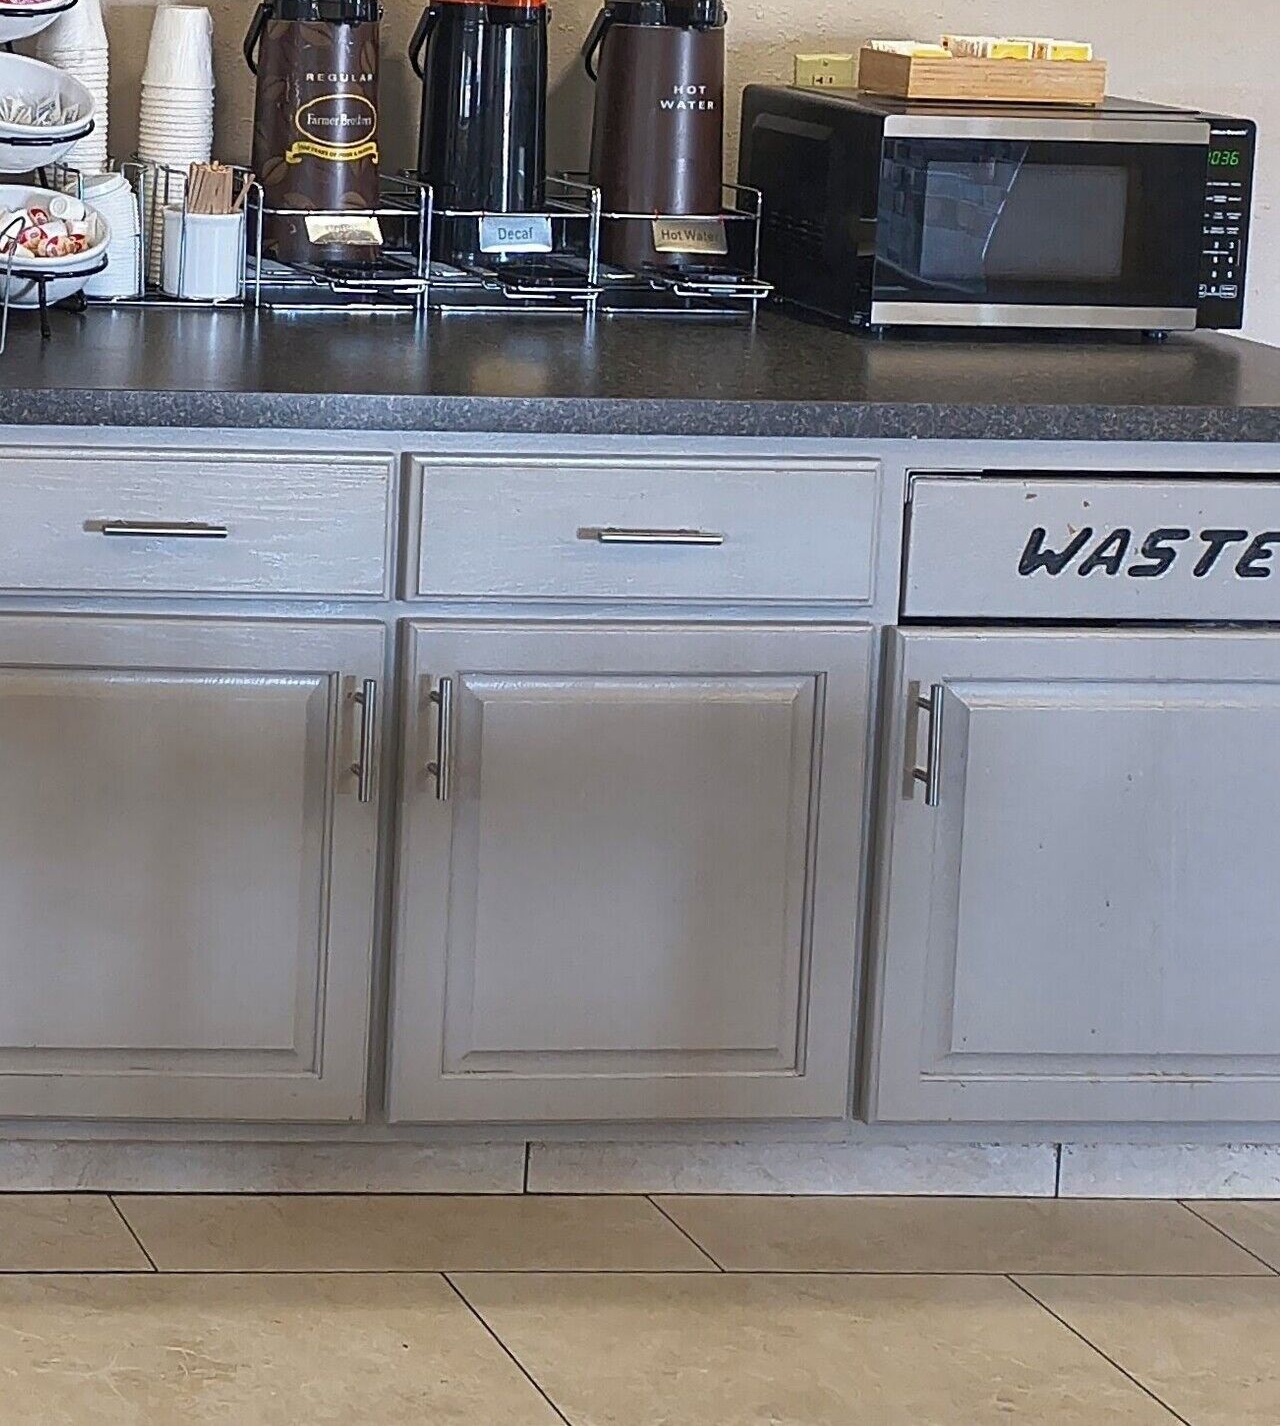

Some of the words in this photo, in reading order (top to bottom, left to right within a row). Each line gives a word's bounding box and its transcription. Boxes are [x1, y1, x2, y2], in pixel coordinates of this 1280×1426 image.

[306, 73, 374, 82] REGULAR
[674, 85, 707, 95] HOT
[660, 100, 714, 110] WATER
[307, 113, 339, 125] Farmer
[498, 227, 533, 240] Decaf
[661, 230, 681, 241] Hot
[1018, 526, 1280, 578] WASTE
